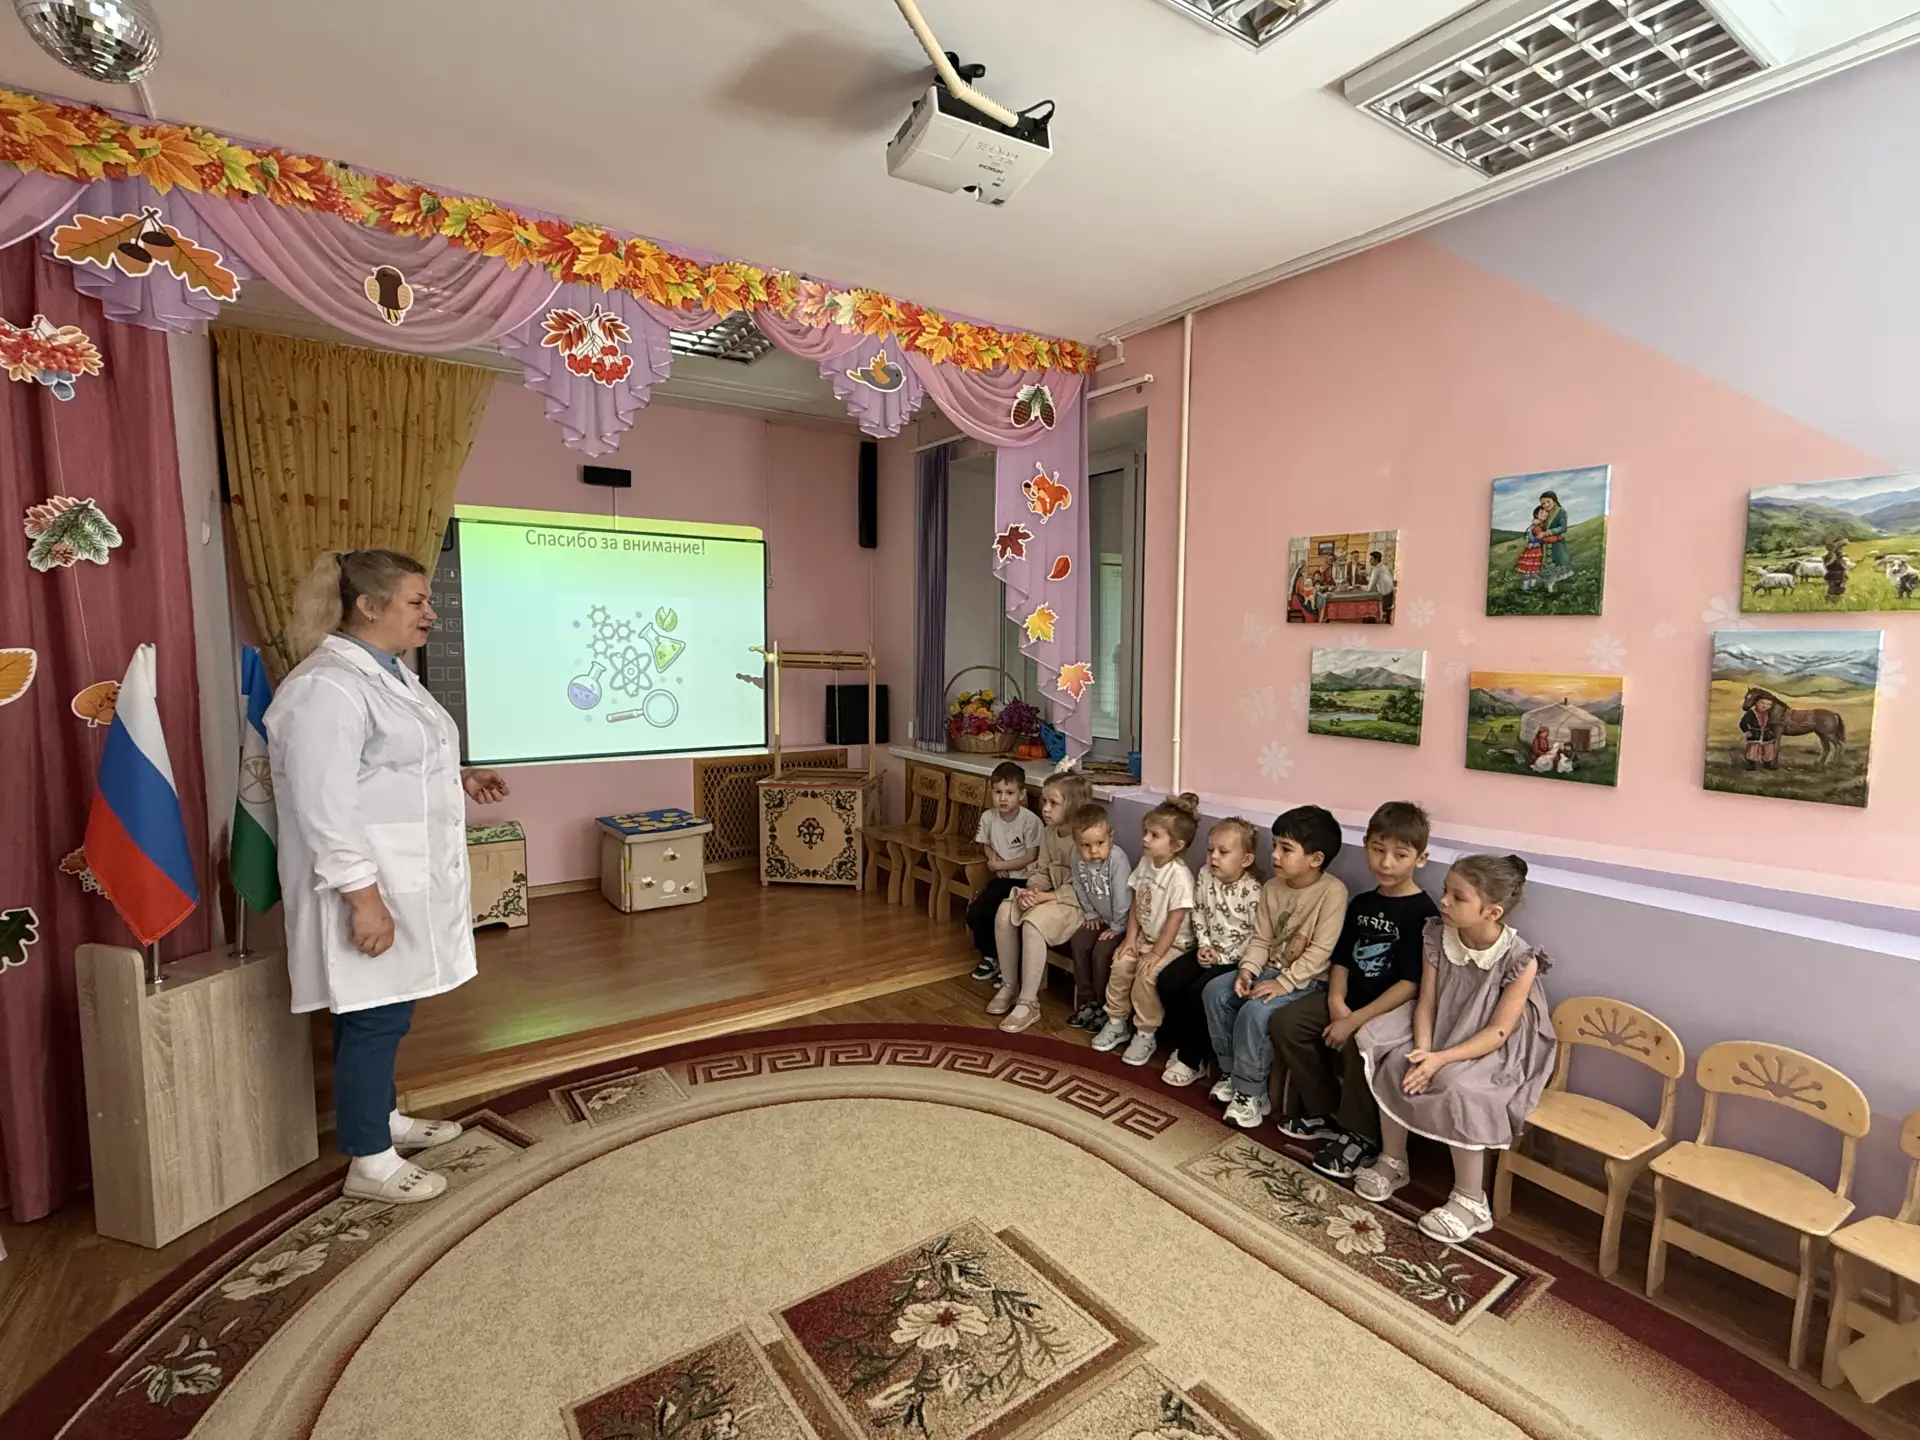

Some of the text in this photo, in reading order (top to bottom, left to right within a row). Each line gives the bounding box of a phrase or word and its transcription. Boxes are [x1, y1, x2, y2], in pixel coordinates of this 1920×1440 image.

[525, 529, 706, 556] Спасибо за внимание!
